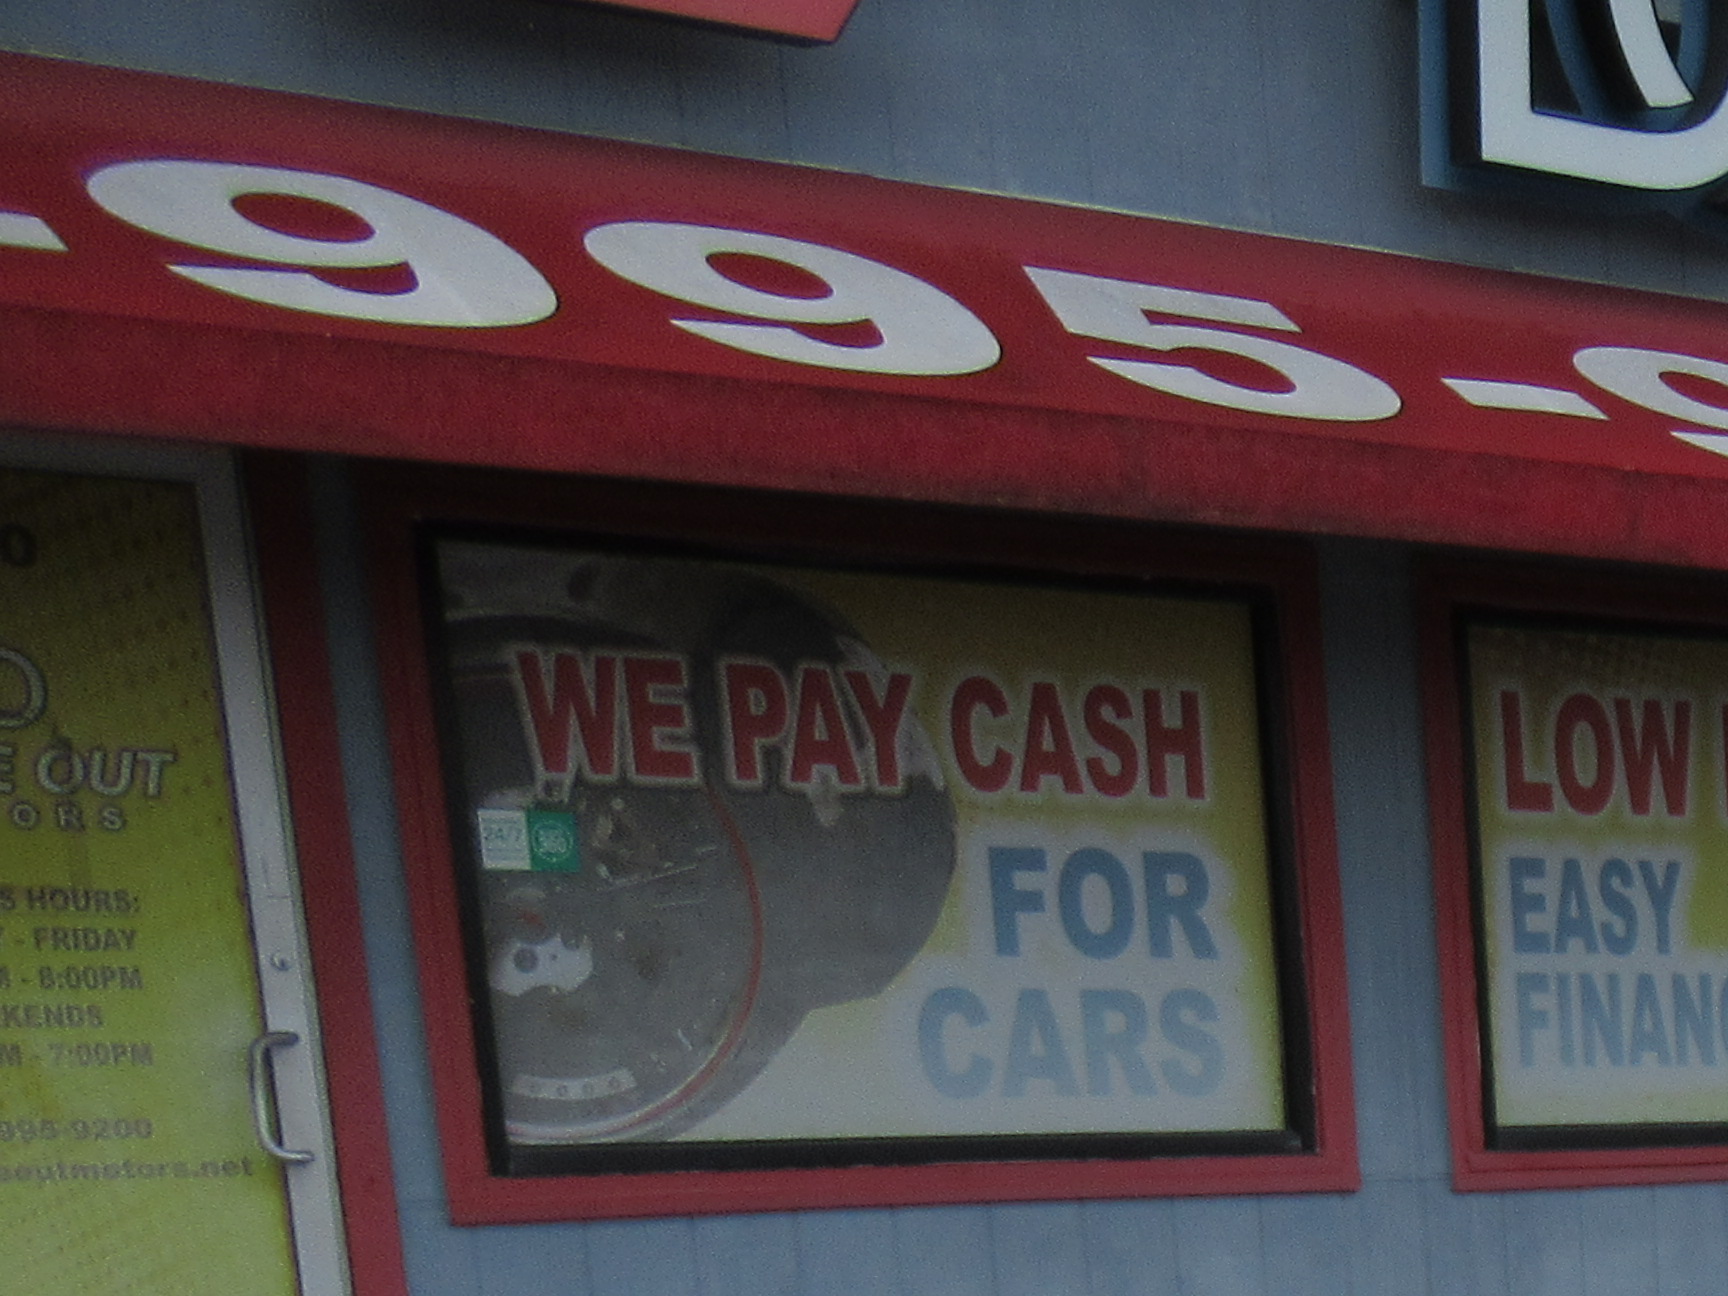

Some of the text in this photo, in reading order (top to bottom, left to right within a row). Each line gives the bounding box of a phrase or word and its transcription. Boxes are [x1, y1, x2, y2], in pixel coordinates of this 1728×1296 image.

[36, 747, 176, 797] OUT
[515, 648, 1207, 801] WE PAY CASH
[1500, 689, 1693, 818] LOW
[33, 926, 138, 952] FRIDAY
[986, 845, 1221, 961] FOR
[1508, 856, 1682, 956] EASY
[916, 987, 1227, 1101] CARS
